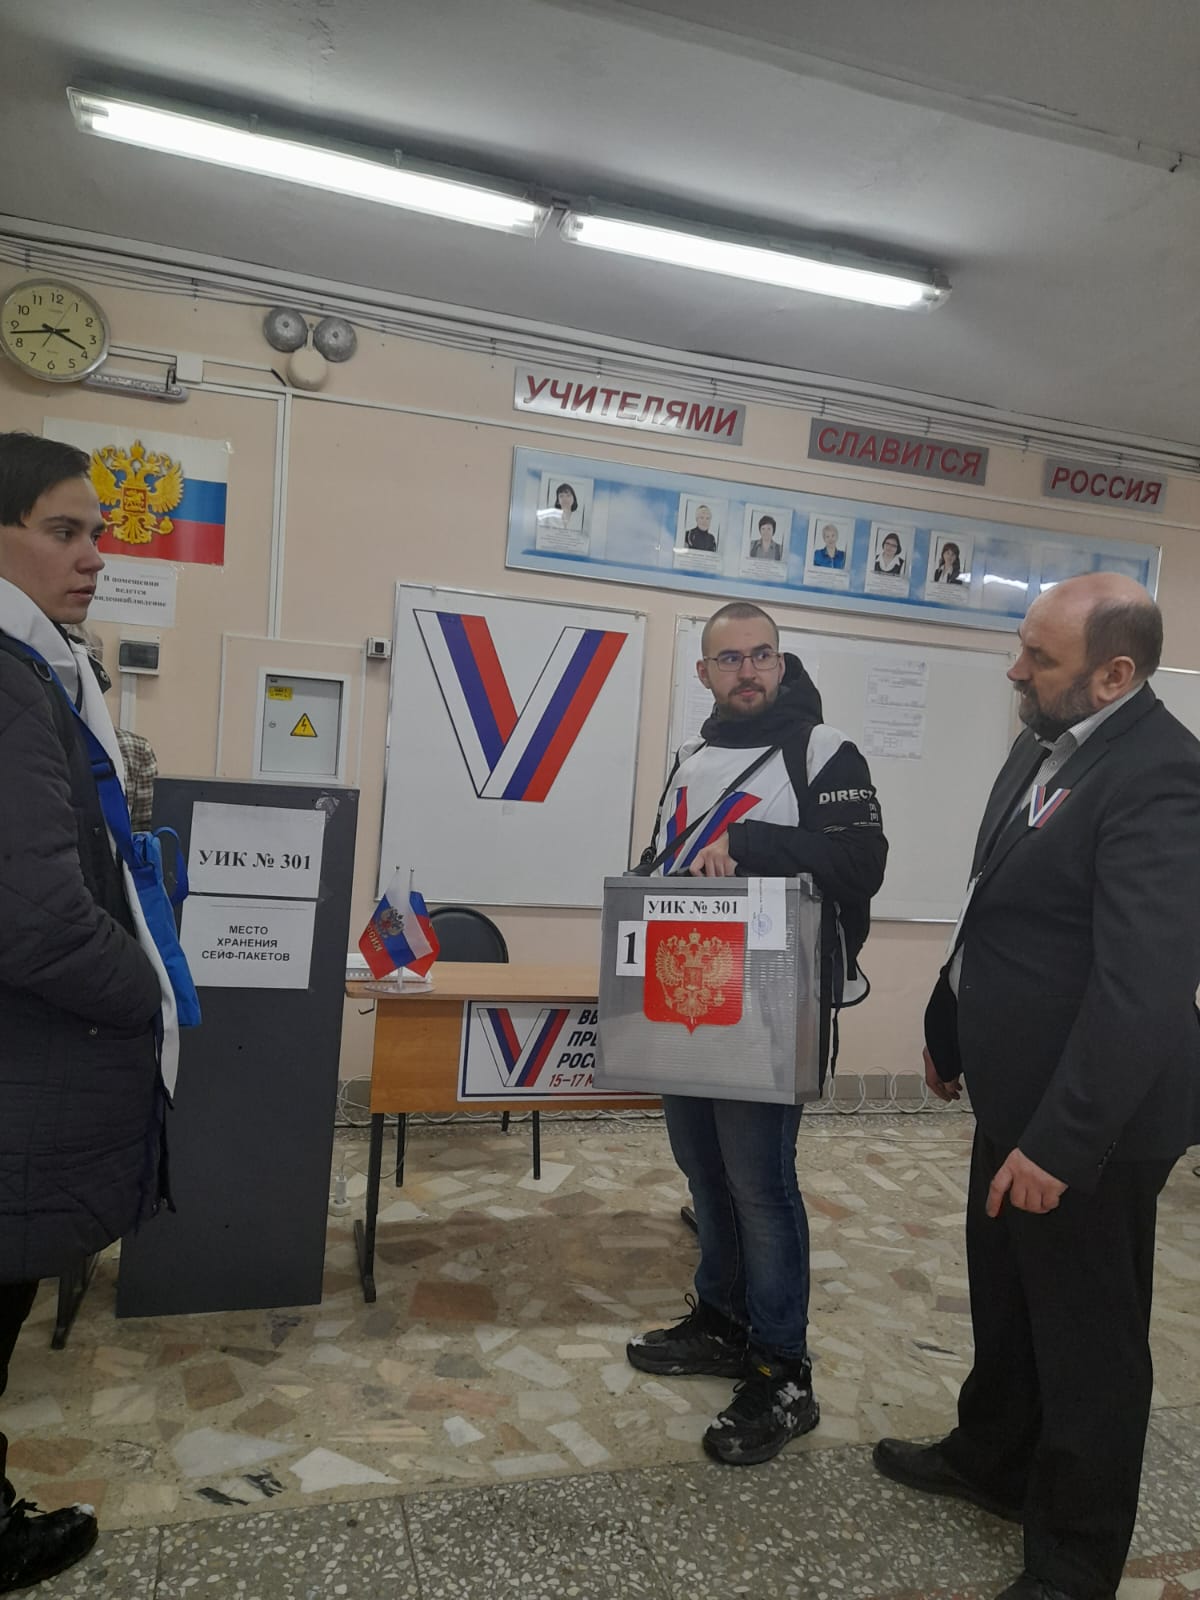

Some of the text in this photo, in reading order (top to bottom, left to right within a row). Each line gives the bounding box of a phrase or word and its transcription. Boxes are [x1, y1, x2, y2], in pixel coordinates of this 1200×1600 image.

[33, 294, 42, 306] 11
[51, 292, 64, 305] 12
[18, 304, 30, 316] 10
[10, 320, 20, 330] 9
[85, 317, 93, 328] 2
[15, 337, 24, 348] 8
[89, 335, 97, 345] 3
[29, 352, 37, 362] 7
[80, 350, 88, 360] 4
[47, 360, 55, 370] 6
[68, 358, 76, 369] 5
[523, 375, 1163, 505] УЧИТЕЛЯМИ СЛАВИТСЯ РОССИЯ
[199, 849, 312, 870] УИК № 301
[647, 900, 738, 915] УИК № 301
[229, 925, 269, 935] МЕСТО
[217, 937, 278, 949] ХРАНЕНИЯ
[623, 931, 638, 965] 1
[201, 949, 290, 962] СЕЙФ-ПАКЕТОВ
[556, 1052, 596, 1069] РОС
